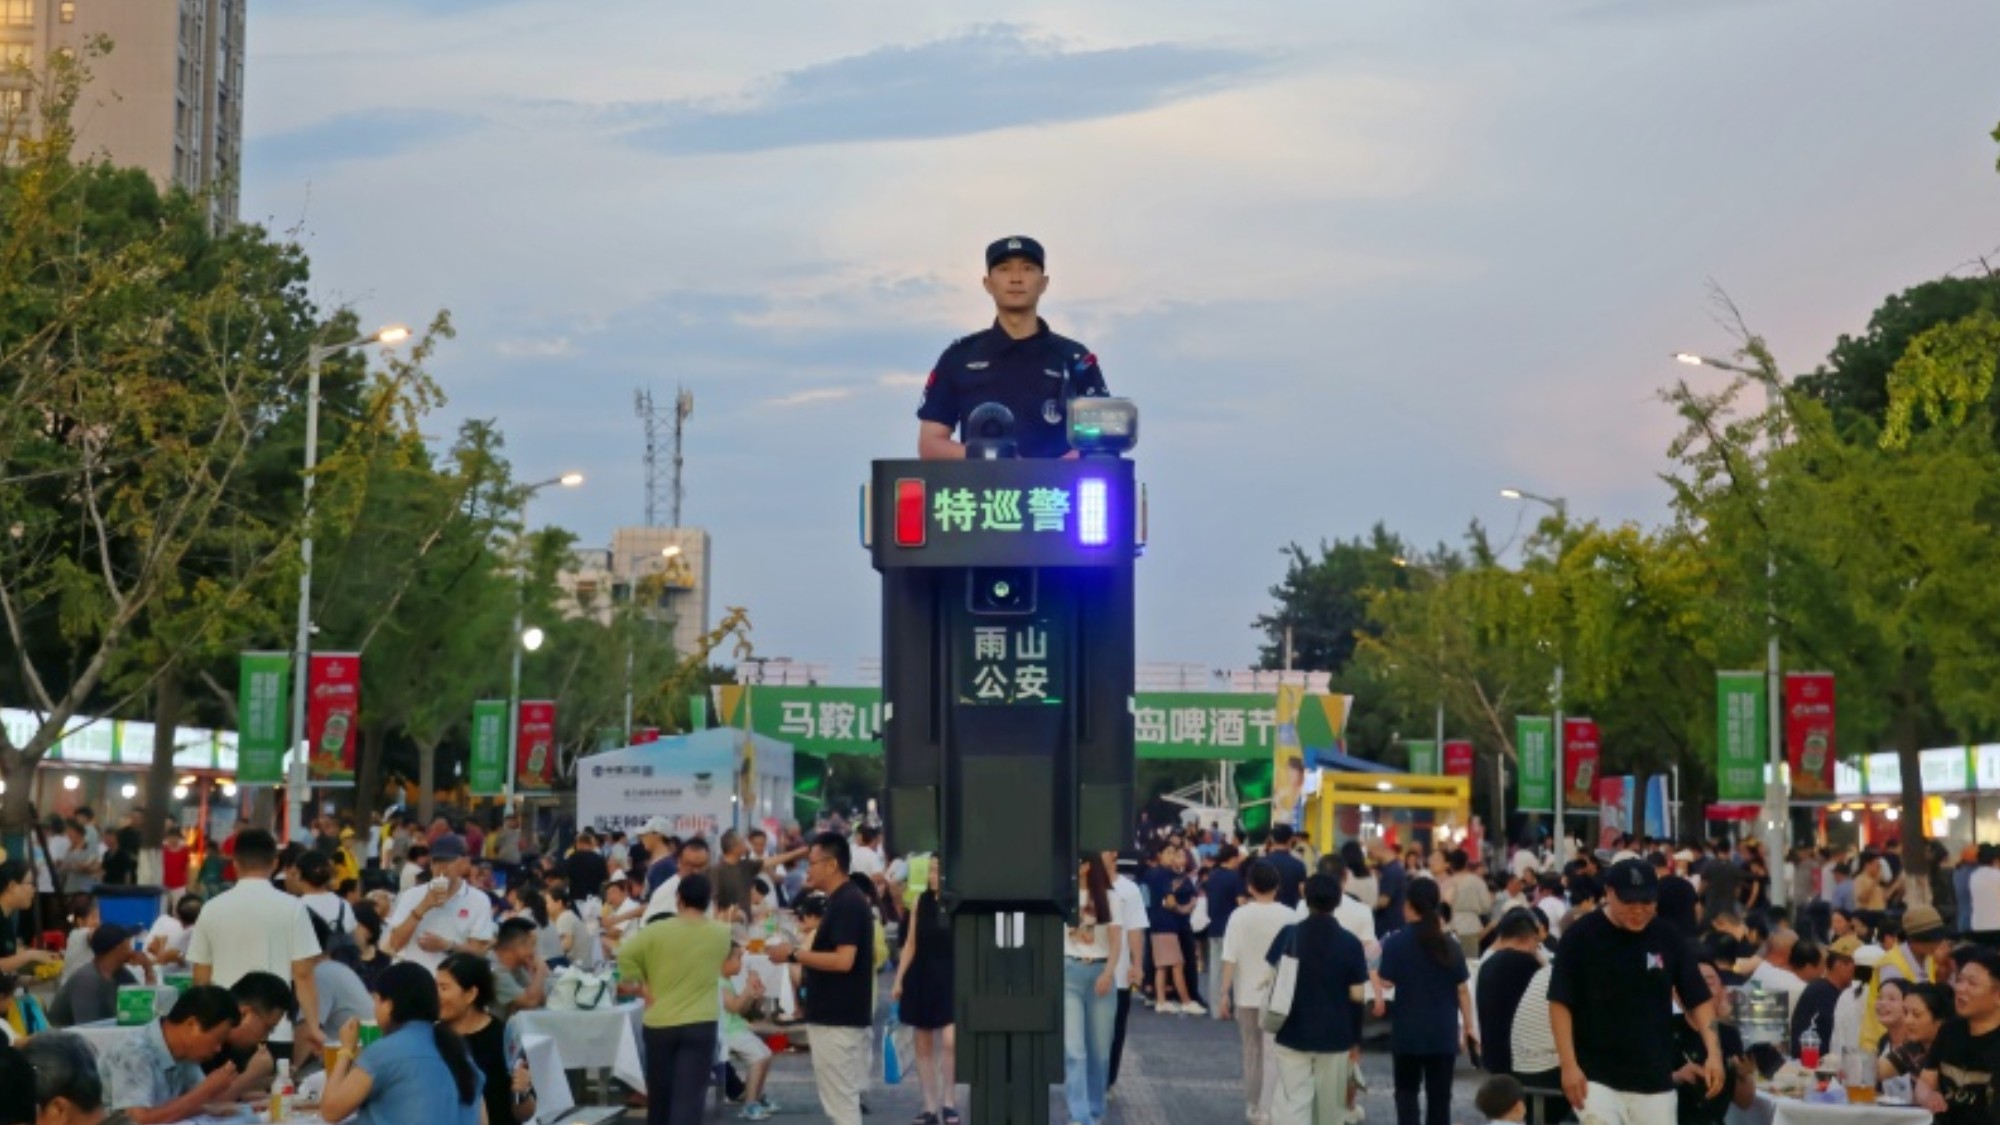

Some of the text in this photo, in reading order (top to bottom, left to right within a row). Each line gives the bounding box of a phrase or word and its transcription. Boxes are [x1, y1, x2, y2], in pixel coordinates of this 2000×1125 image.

[934, 487, 1070, 532] 特巡警
[973, 626, 1047, 660] 雨山
[973, 664, 1048, 698] 公安
[779, 702, 1276, 746] 马鞍山 岛啤酒节
